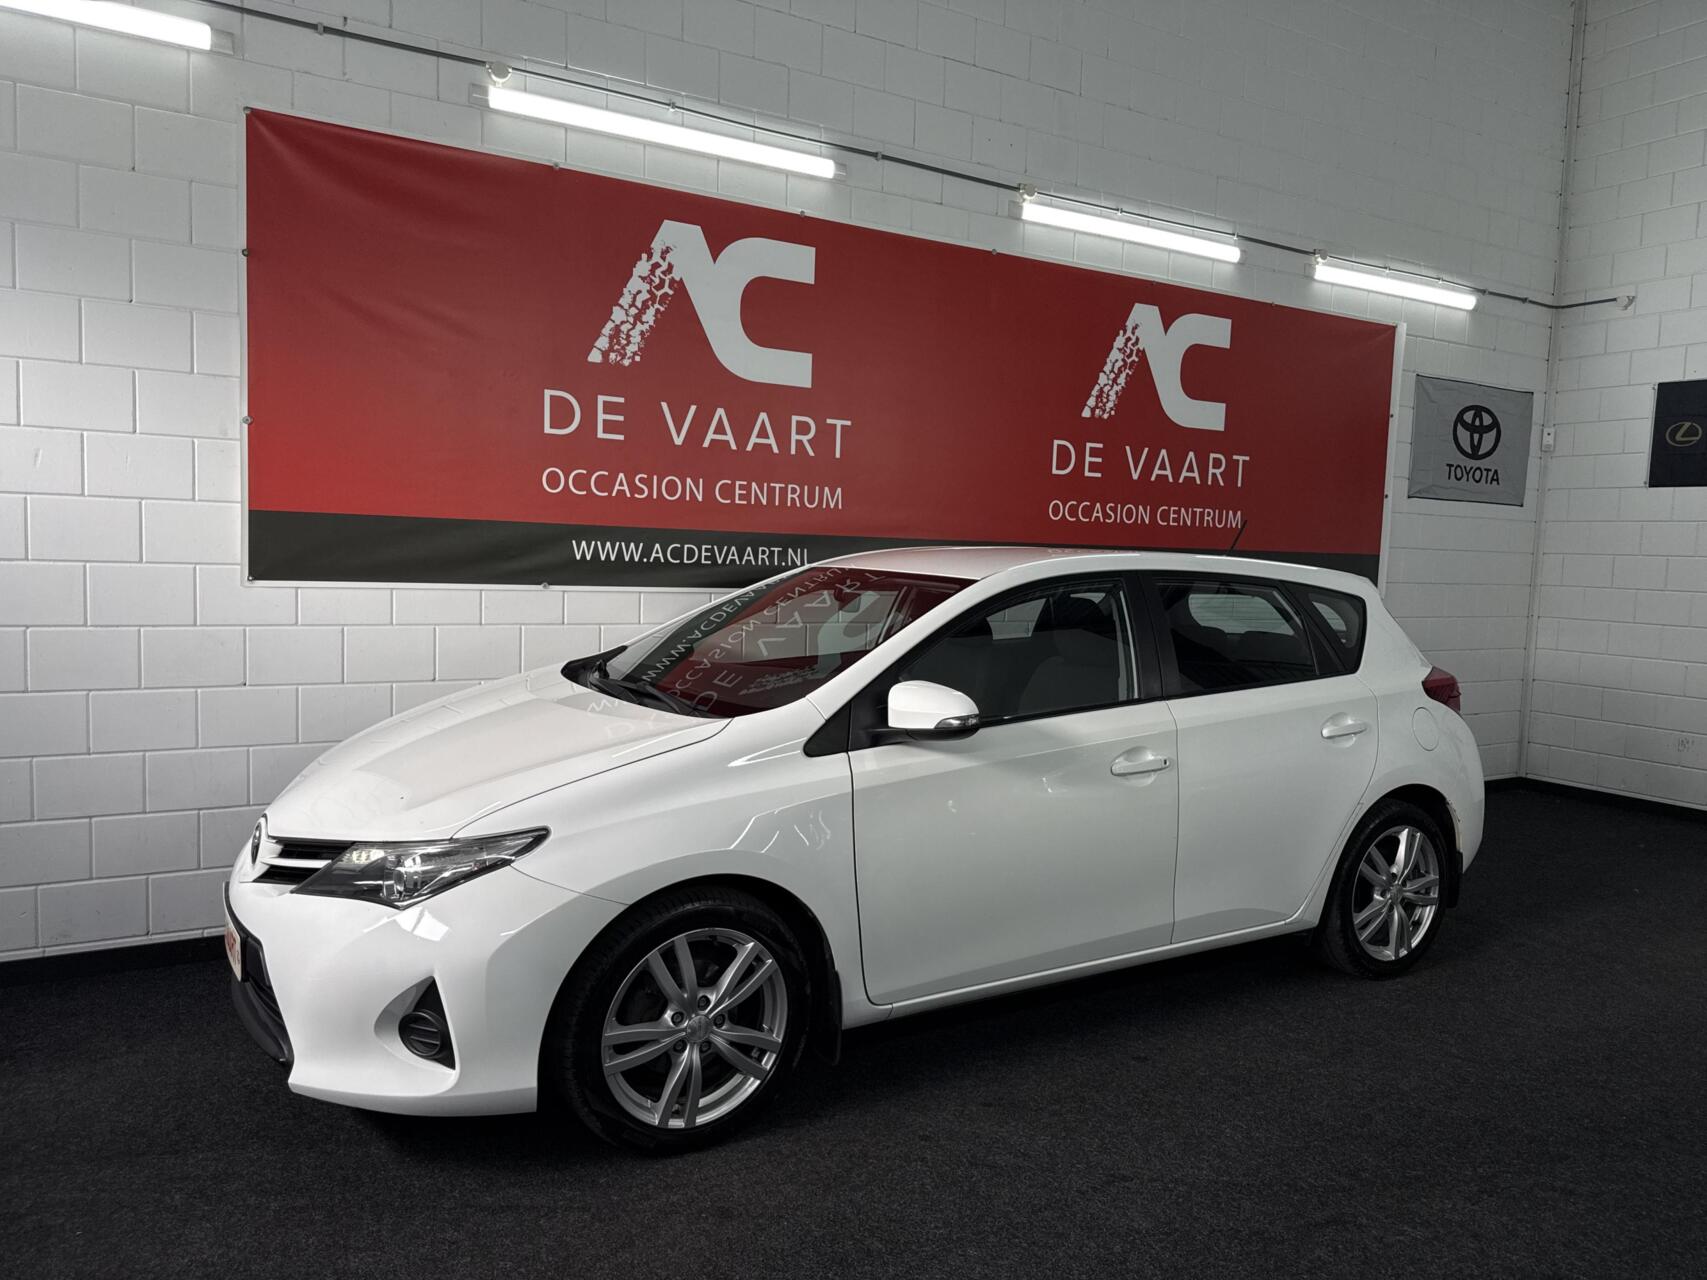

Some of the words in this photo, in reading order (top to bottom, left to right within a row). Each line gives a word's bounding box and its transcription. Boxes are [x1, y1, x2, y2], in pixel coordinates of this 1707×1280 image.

[587, 219, 816, 388] AC
[1081, 303, 1232, 431] AC
[543, 389, 625, 440] DE
[660, 401, 852, 459] VAART
[1051, 439, 1104, 478] DE
[1125, 445, 1250, 487] VAART
[1446, 463, 1500, 486] TOYOTA
[541, 467, 703, 501] OCCASION
[715, 480, 842, 509] CENTRUM
[1048, 500, 1150, 525] OCCASION
[1156, 506, 1242, 529] CENTRUM
